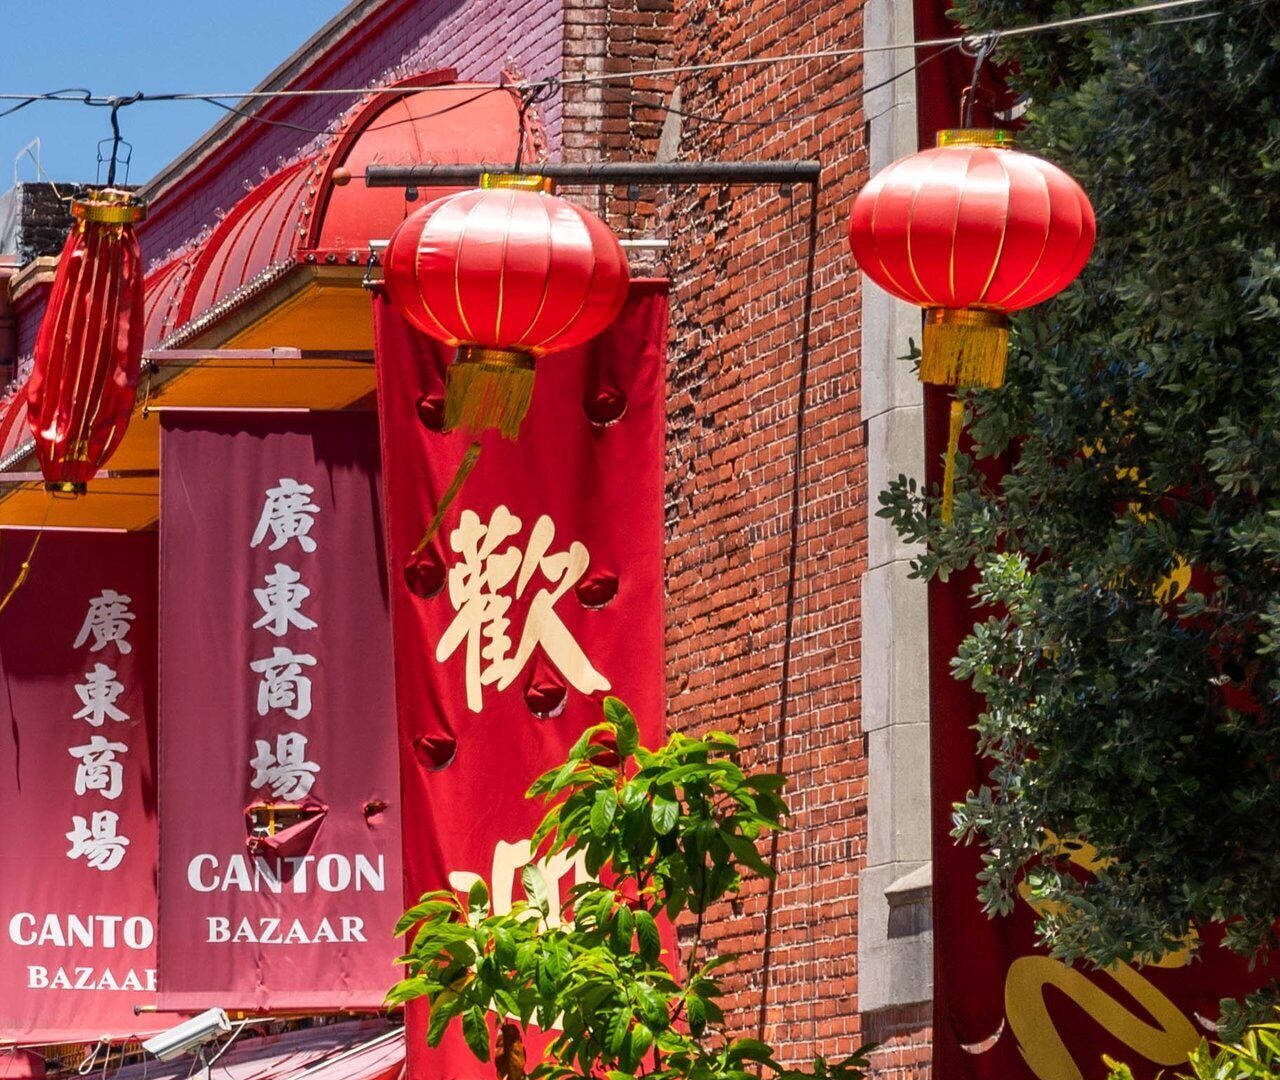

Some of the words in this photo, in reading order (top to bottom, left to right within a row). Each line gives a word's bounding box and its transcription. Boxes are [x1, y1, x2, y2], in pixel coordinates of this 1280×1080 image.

[249, 477, 322, 803] 廣東商場
[65, 588, 137, 872] 廣東商場
[187, 852, 386, 894] CANTON
[7, 911, 155, 950] CANTO
[205, 915, 369, 944] BAZAAR
